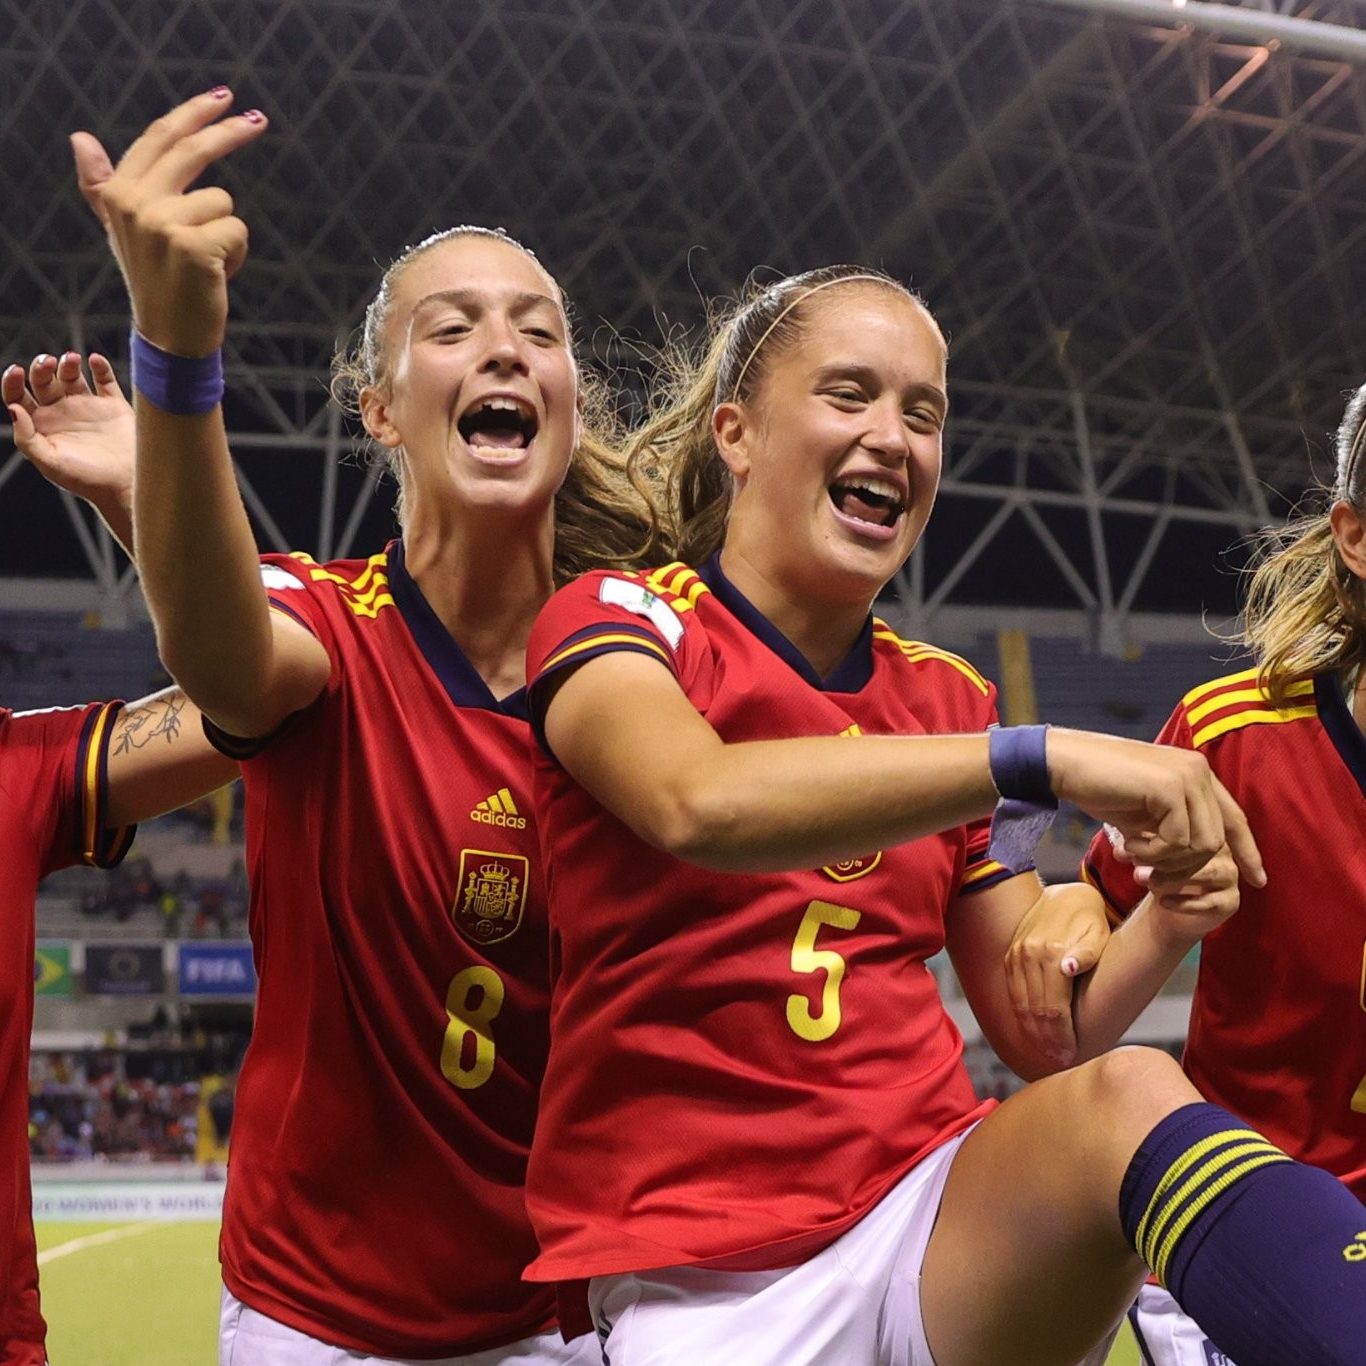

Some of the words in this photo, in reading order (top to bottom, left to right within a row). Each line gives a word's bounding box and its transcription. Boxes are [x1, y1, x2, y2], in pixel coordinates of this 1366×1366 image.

[469, 809, 527, 830] adidas
[186, 957, 247, 983] FIFA
[786, 899, 863, 1041] 5
[439, 965, 505, 1090] 8
